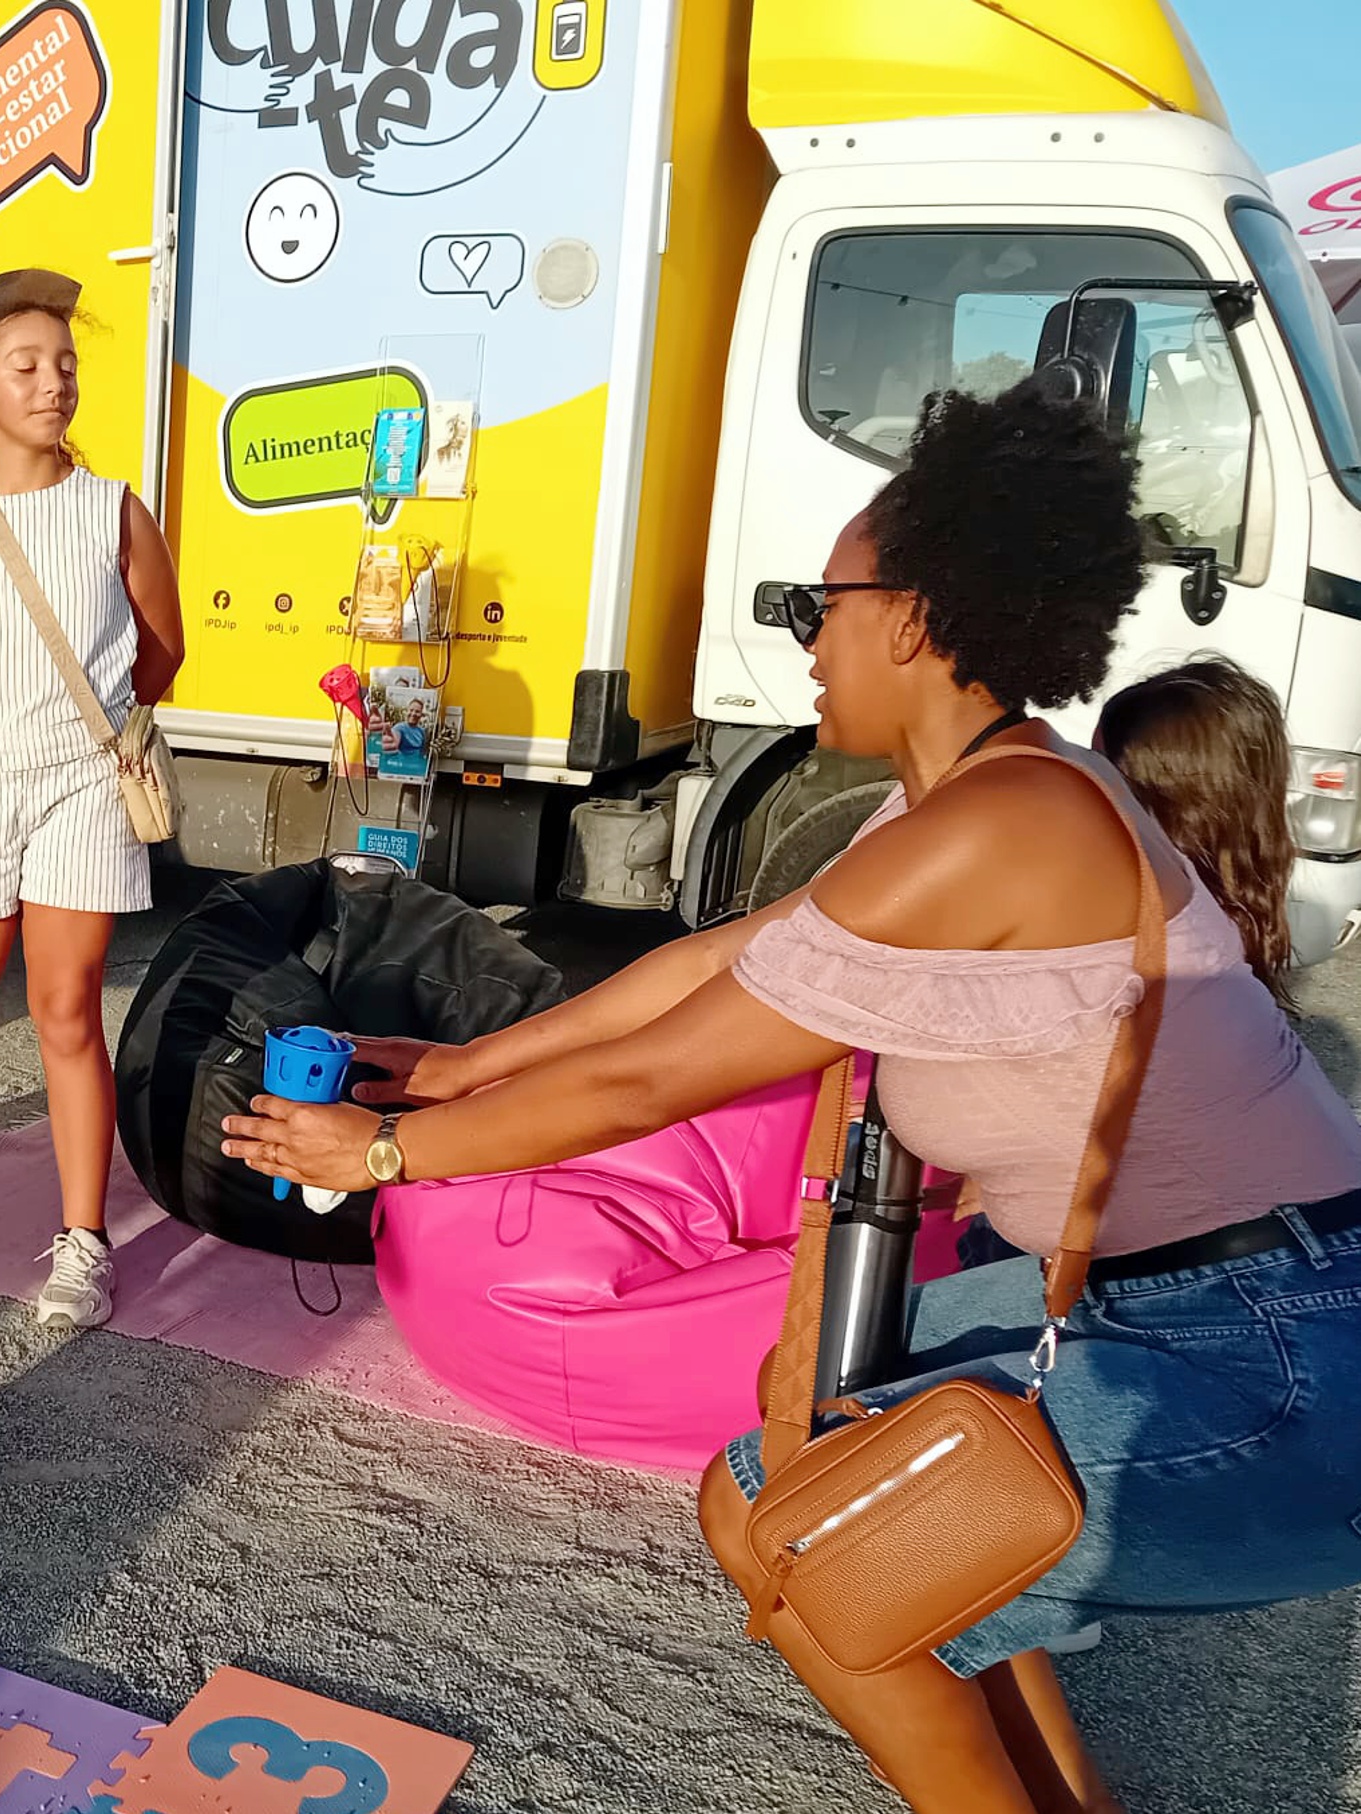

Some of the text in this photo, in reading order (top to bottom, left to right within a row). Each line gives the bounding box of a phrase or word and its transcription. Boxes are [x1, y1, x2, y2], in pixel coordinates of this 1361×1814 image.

[204, 618, 237, 631] IPDJip
[265, 622, 300, 634] ipdj_ip
[326, 625, 351, 636] IPD
[368, 833, 408, 845] GUIA DOS
[368, 840, 407, 852] DIREITOS
[187, 1716, 389, 1814] 3
